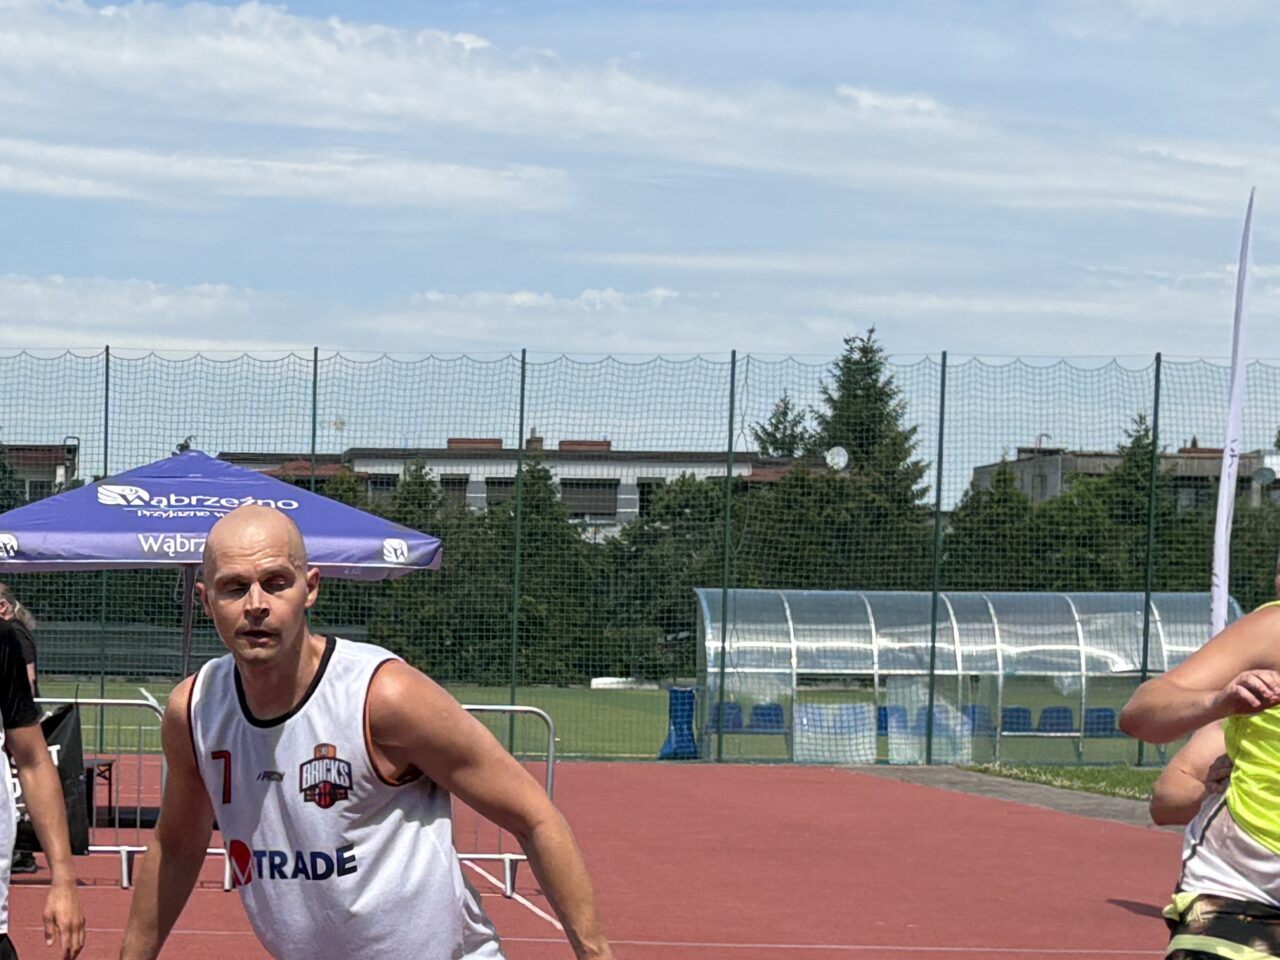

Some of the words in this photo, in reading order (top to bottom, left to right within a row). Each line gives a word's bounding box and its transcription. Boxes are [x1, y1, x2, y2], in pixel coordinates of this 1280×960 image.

[137, 533, 206, 557] Wąbrz
[211, 750, 232, 805] 7
[302, 758, 351, 790] BRICKS
[253, 843, 358, 881] TRADE
